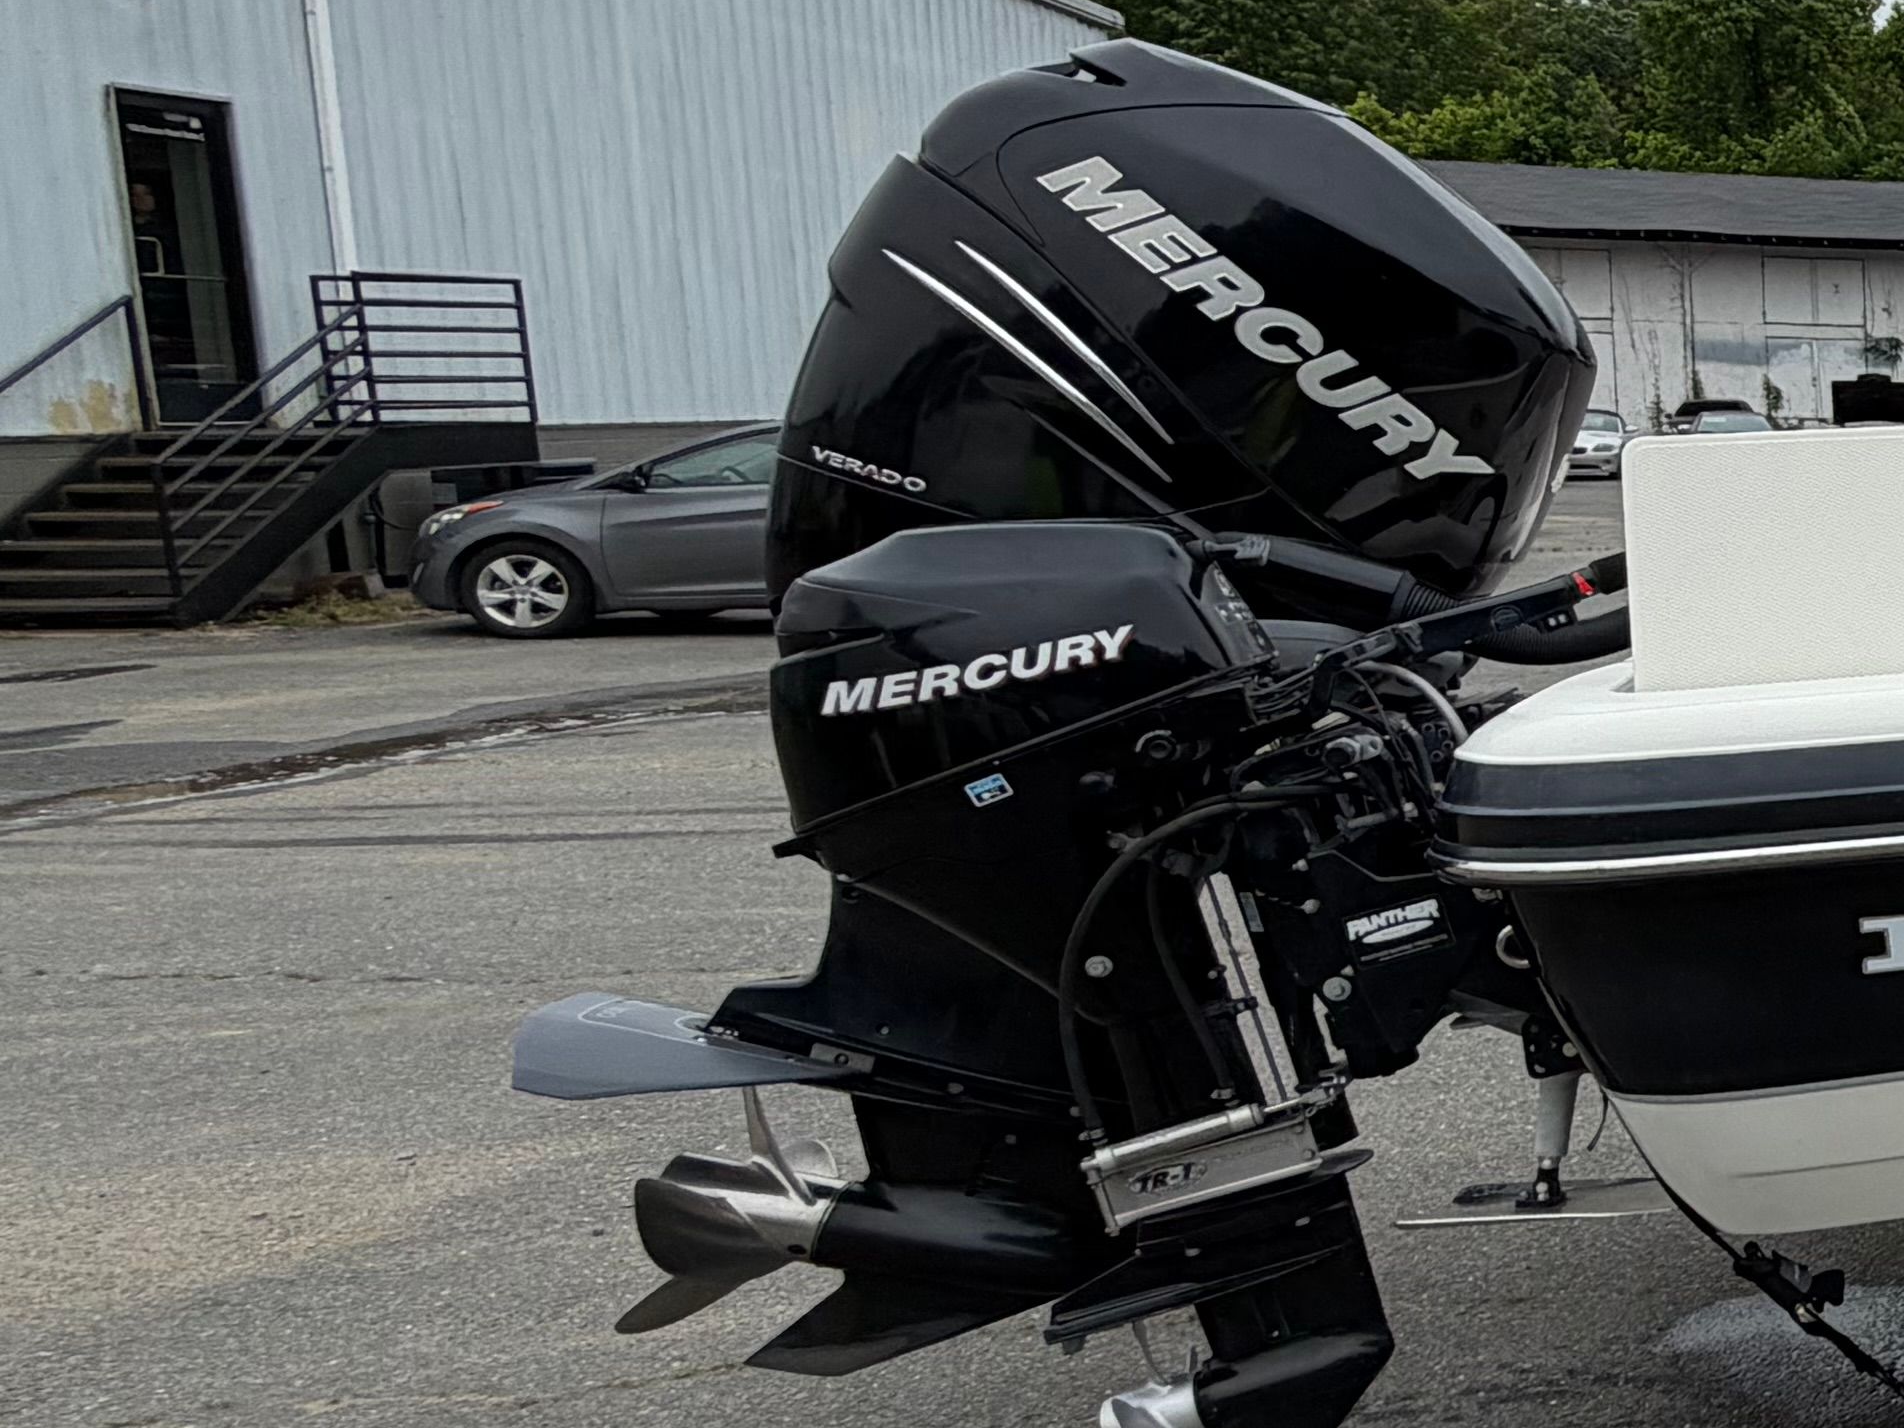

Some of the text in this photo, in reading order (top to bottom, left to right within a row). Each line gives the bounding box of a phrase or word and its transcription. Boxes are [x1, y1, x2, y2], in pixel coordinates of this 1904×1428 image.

[1035, 155, 1497, 481] MERCURY
[811, 445, 928, 492] VERADO
[820, 623, 1135, 716] MERCURY
[1346, 898, 1441, 942] PANTHER
